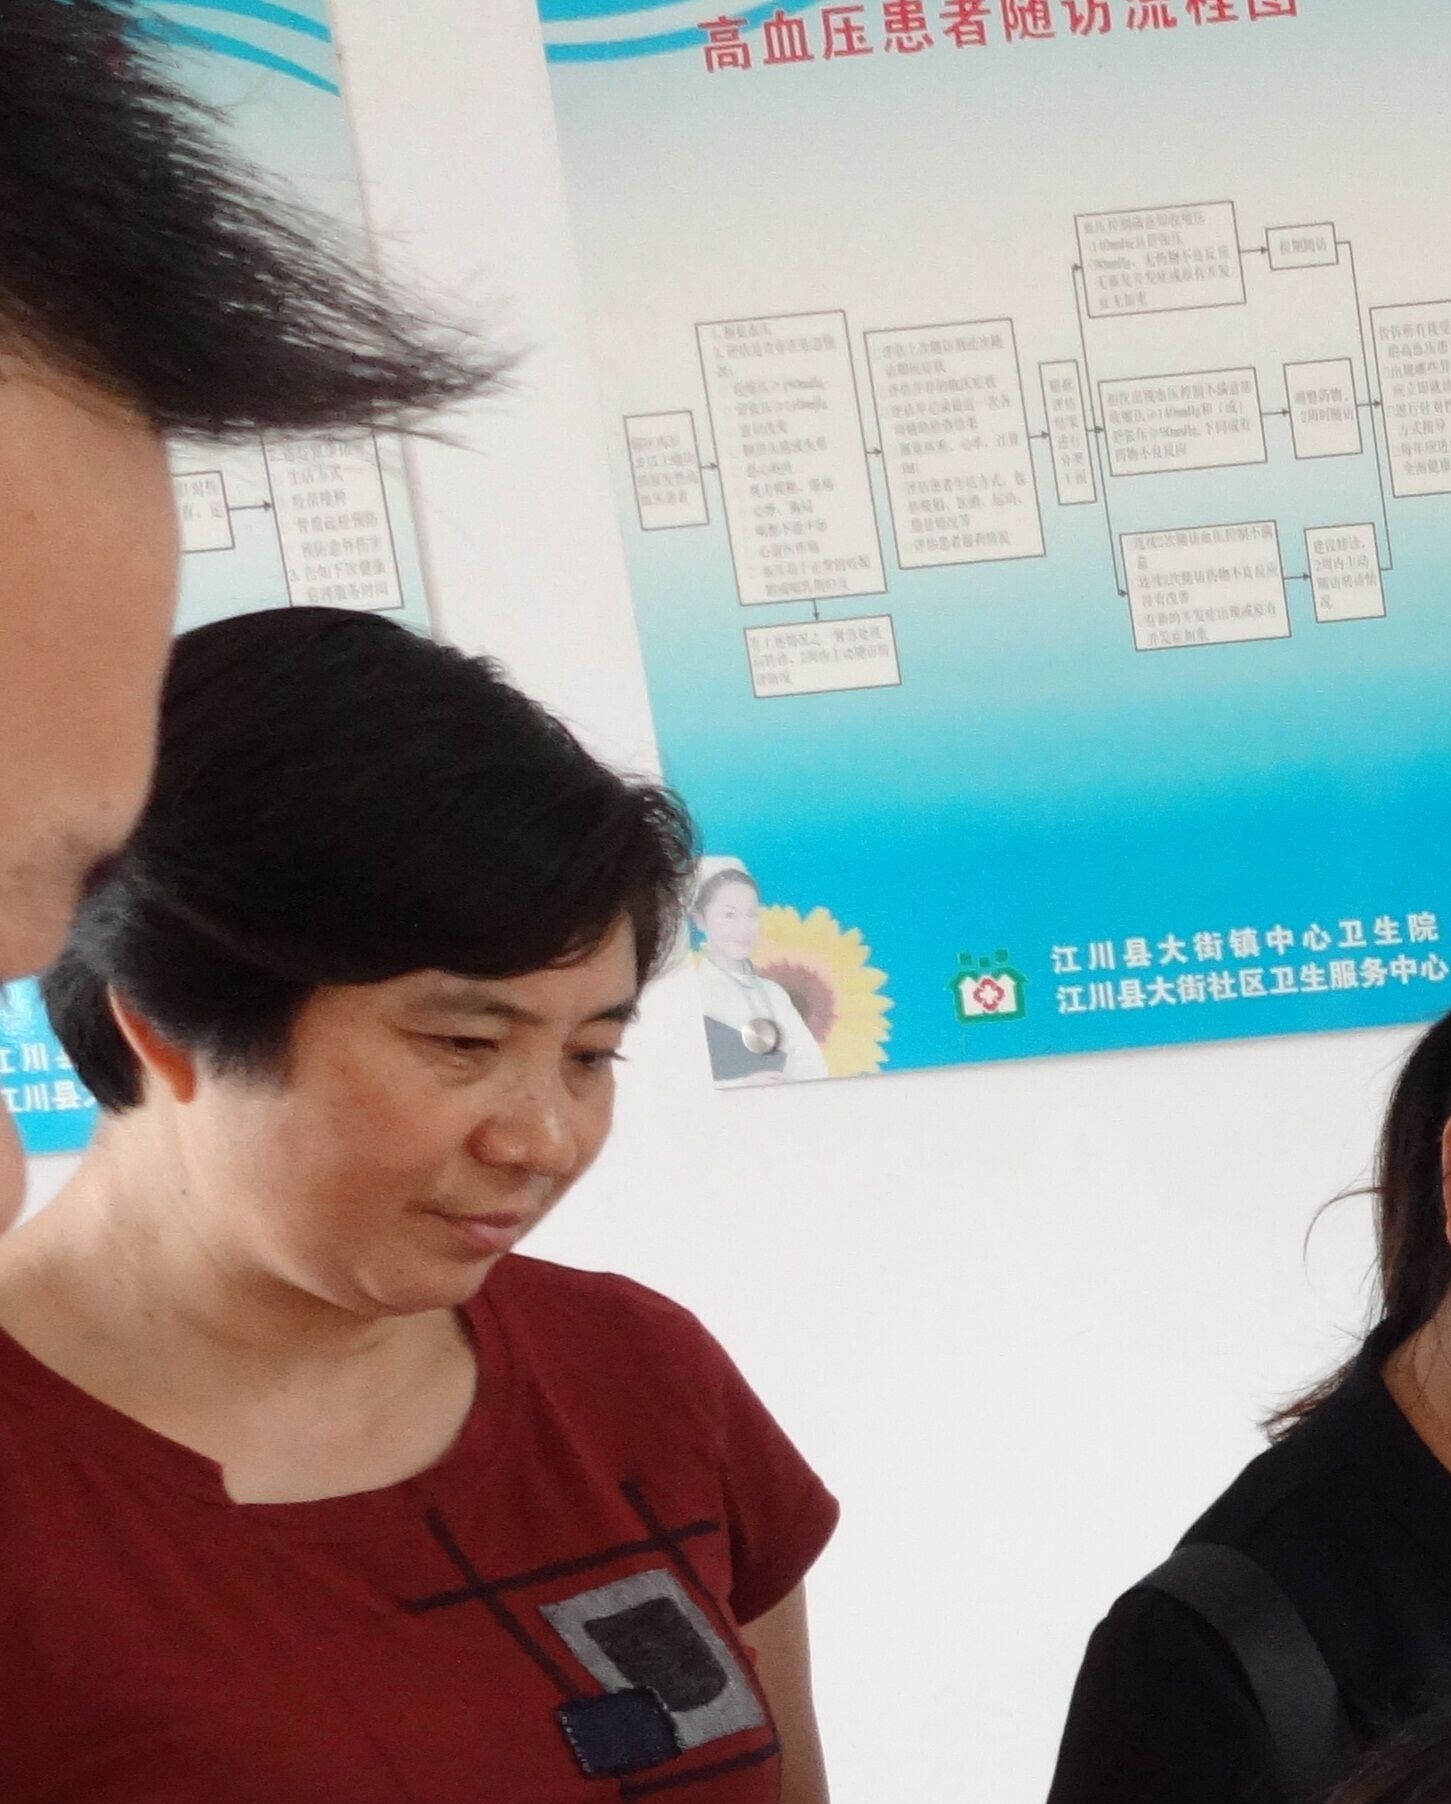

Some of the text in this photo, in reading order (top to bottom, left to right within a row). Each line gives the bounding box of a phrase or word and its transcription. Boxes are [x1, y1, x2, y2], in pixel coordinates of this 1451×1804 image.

[1051, 911, 1440, 975] 江川县大街镇中心卫生院
[1056, 953, 1449, 1014] 江川县大街社区卫生服务中心
